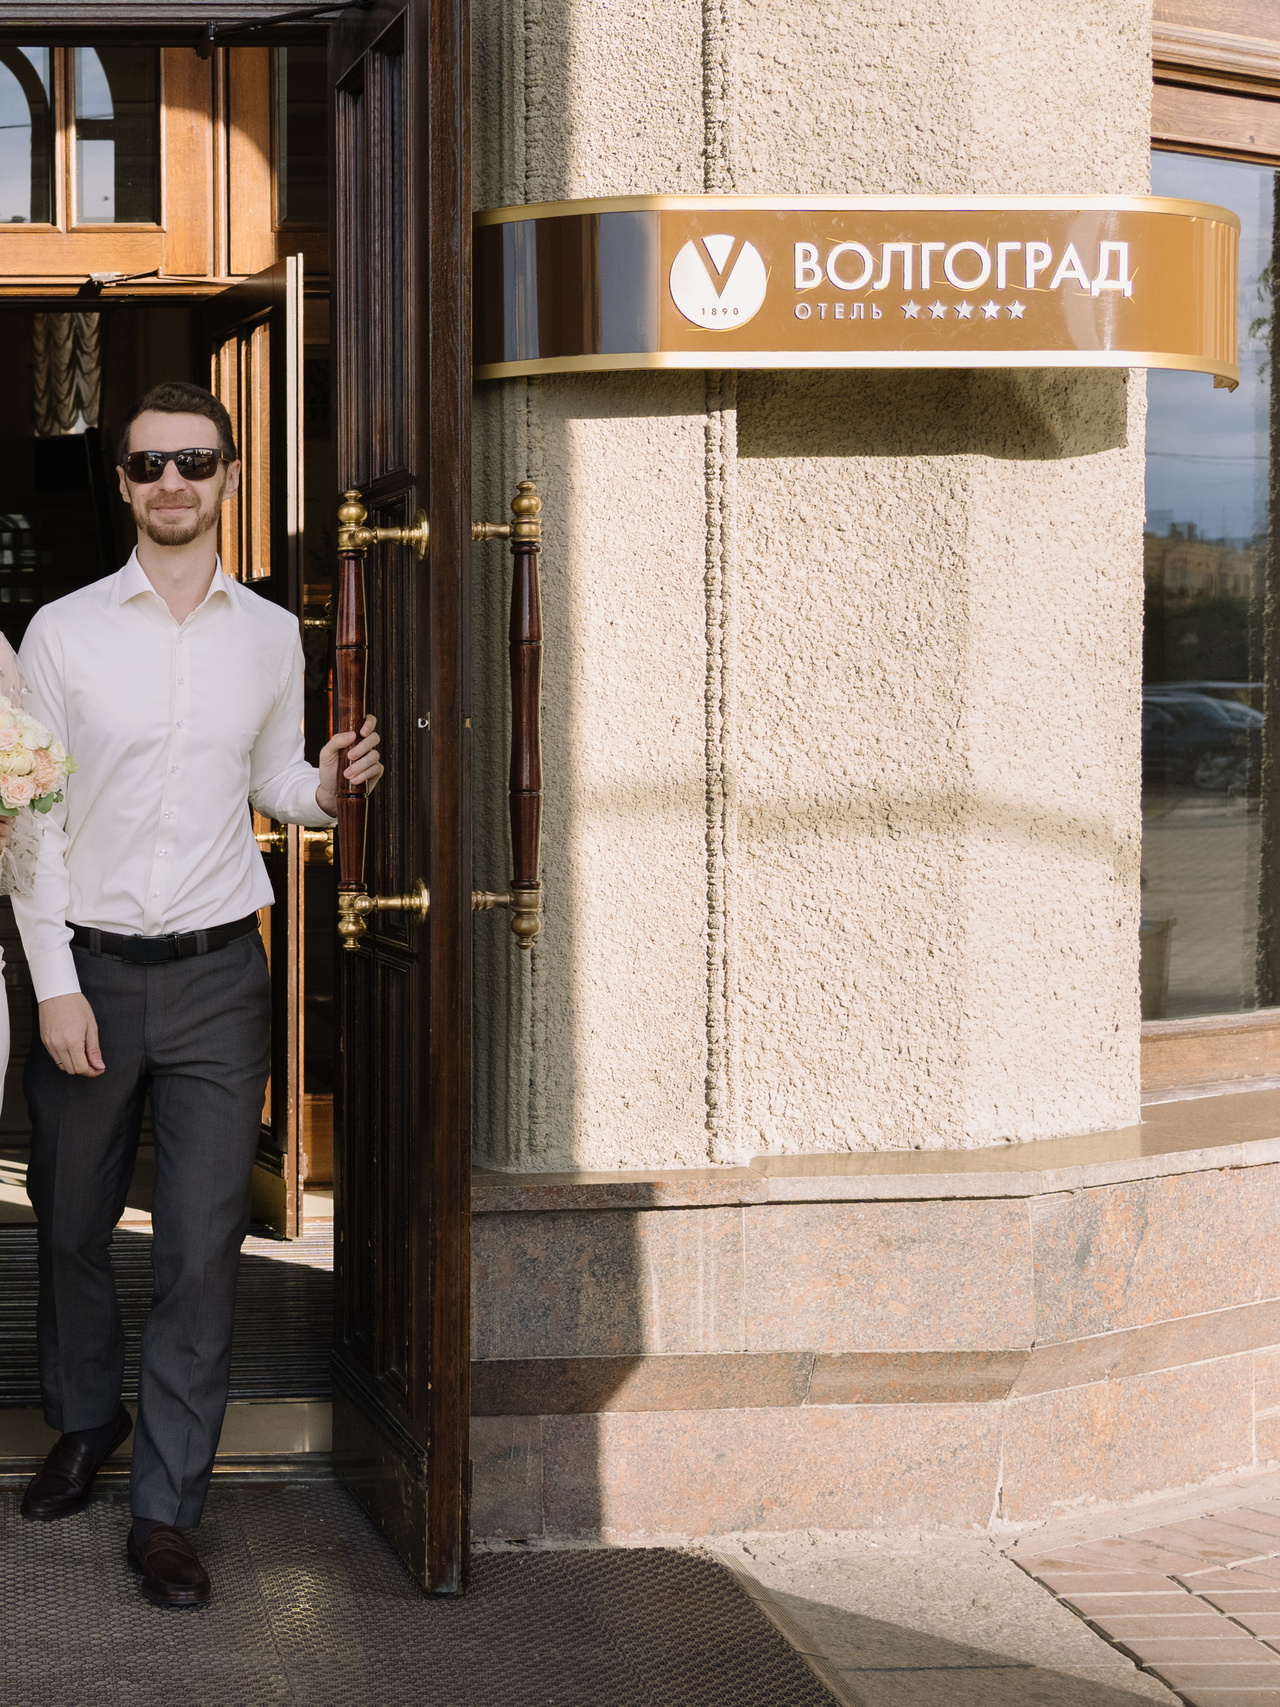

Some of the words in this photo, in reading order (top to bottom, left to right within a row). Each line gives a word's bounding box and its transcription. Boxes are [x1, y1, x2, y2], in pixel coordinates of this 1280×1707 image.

[690, 235, 747, 299] V
[794, 241, 1132, 297] ВОЛГОГРАД
[700, 306, 739, 317] 1890
[793, 302, 883, 320] ОТЕЛЬ
